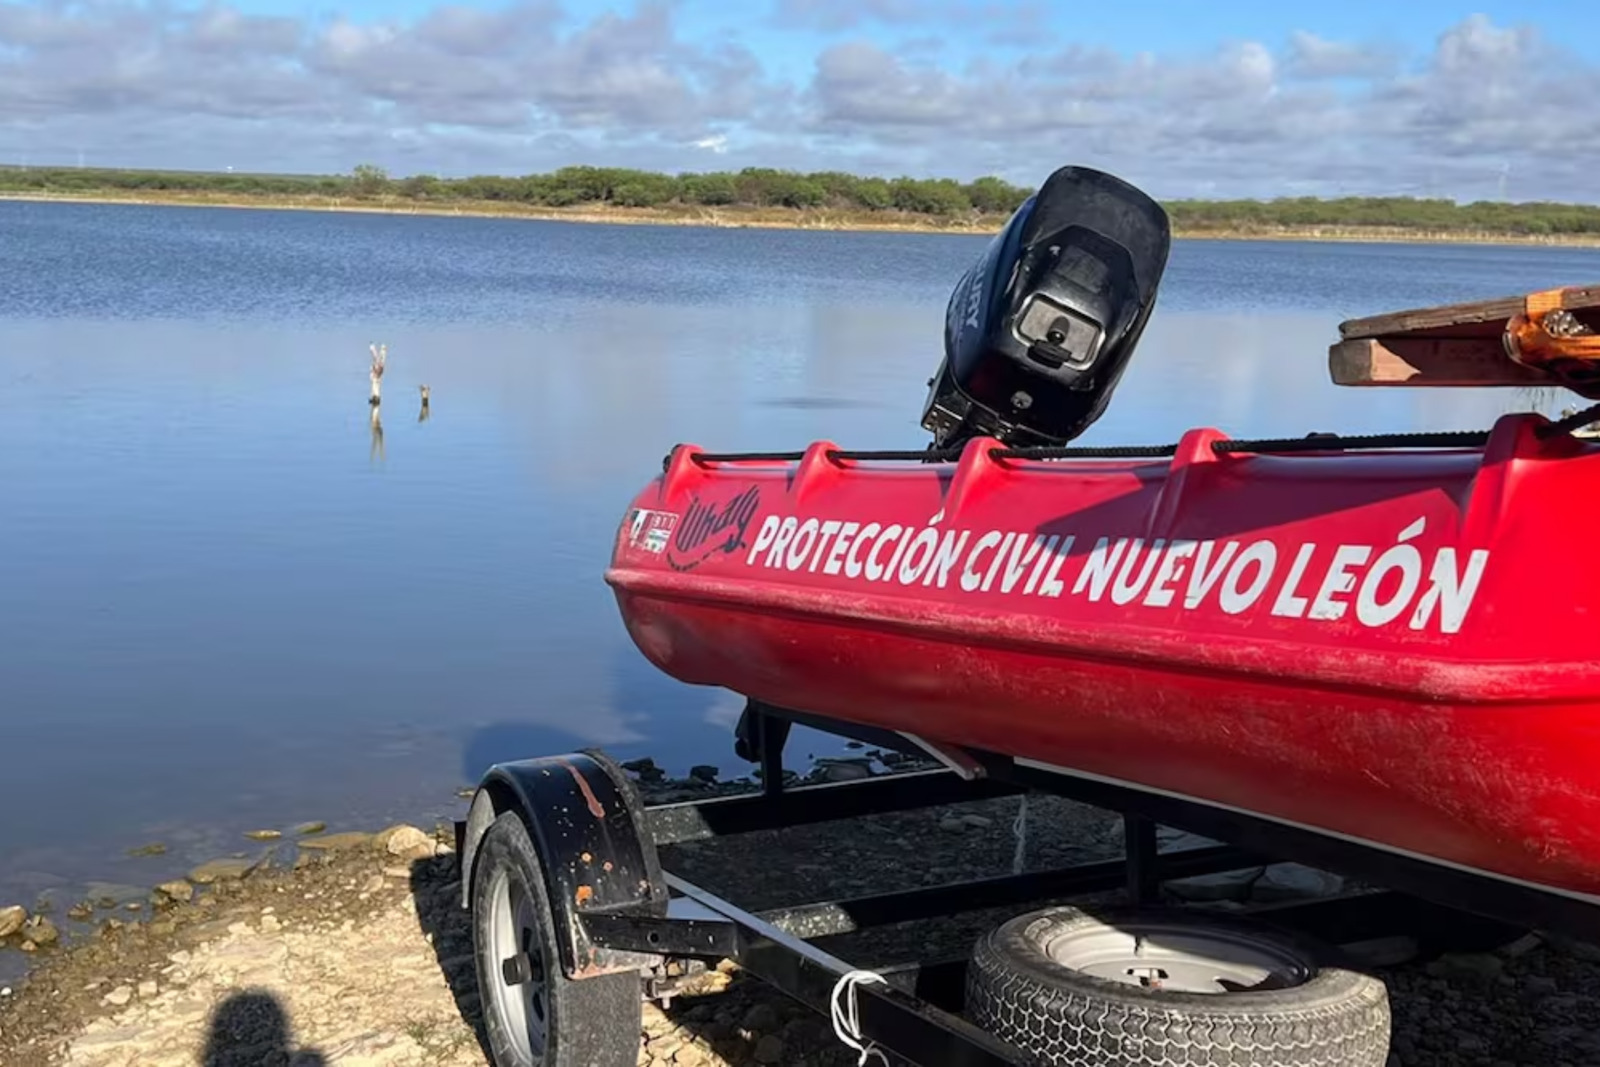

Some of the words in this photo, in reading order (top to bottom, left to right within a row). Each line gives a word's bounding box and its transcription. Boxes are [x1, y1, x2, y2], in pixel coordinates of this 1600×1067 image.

[747, 508, 970, 588] PROTECCIÓN
[960, 531, 1075, 597] CIVIL
[1072, 537, 1277, 614] NUEVO
[1271, 516, 1489, 633] LEÓN
